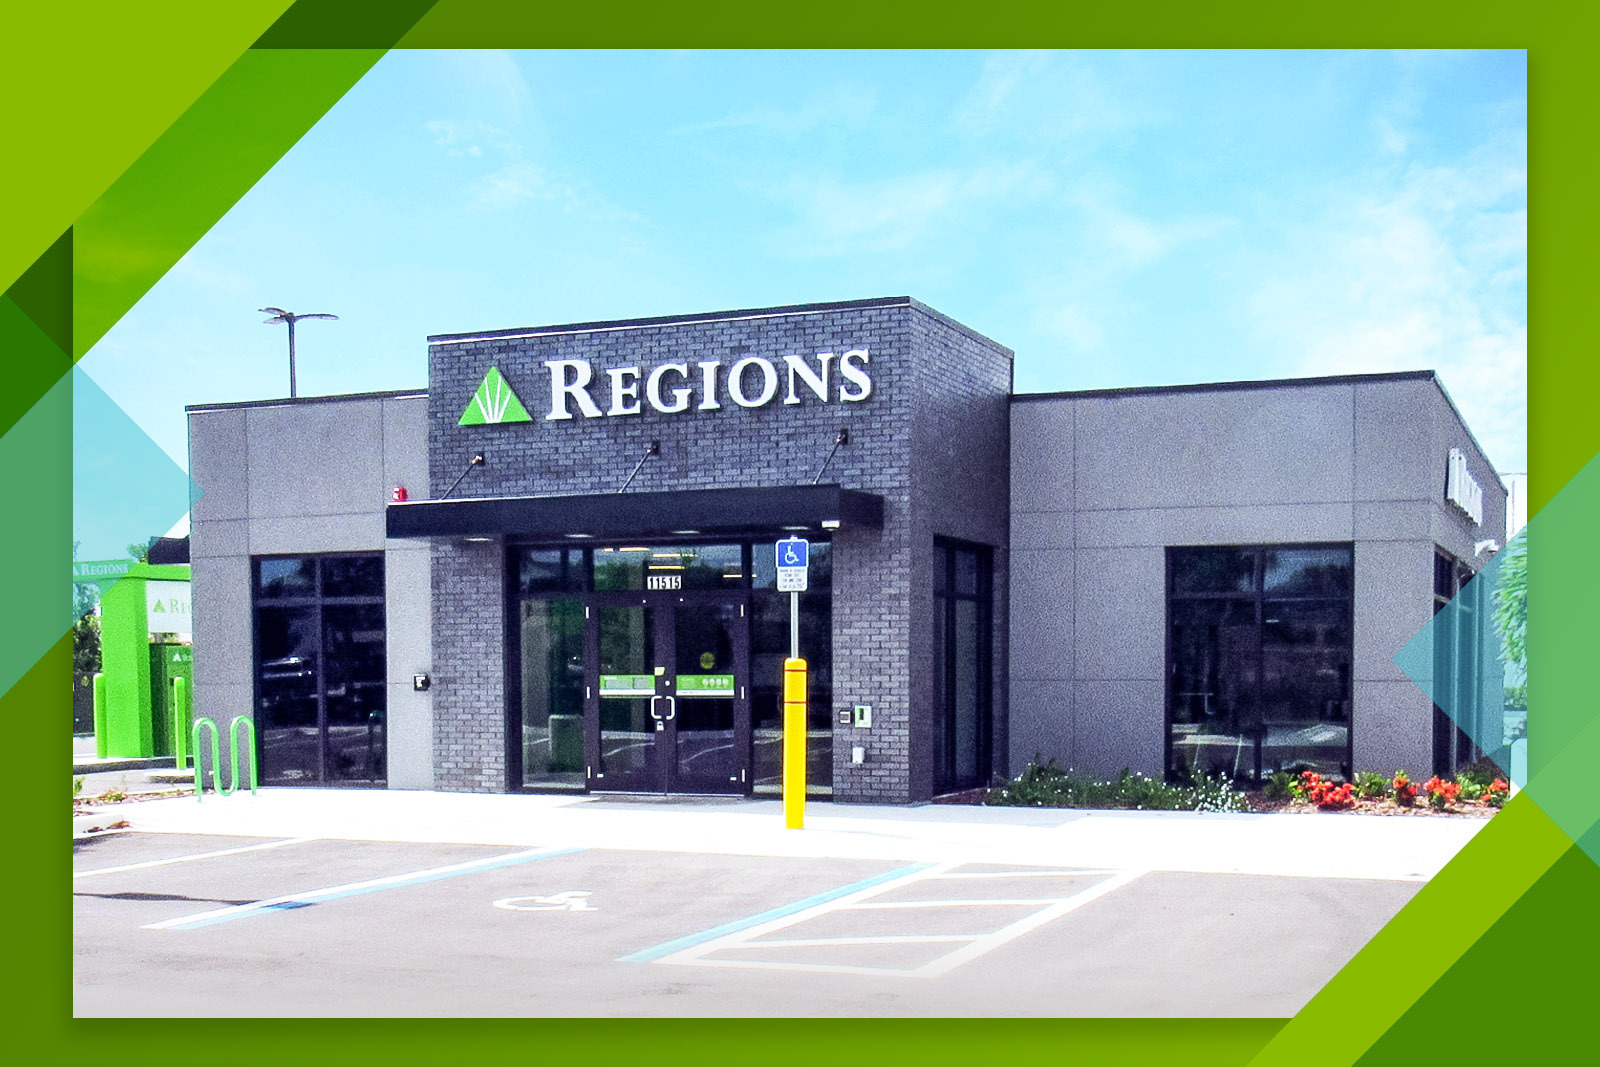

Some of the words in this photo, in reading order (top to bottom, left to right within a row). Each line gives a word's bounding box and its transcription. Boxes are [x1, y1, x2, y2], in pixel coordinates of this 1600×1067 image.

[544, 348, 873, 421] REGIONS
[80, 562, 129, 576] REGIONS
[648, 576, 680, 589] 11515
